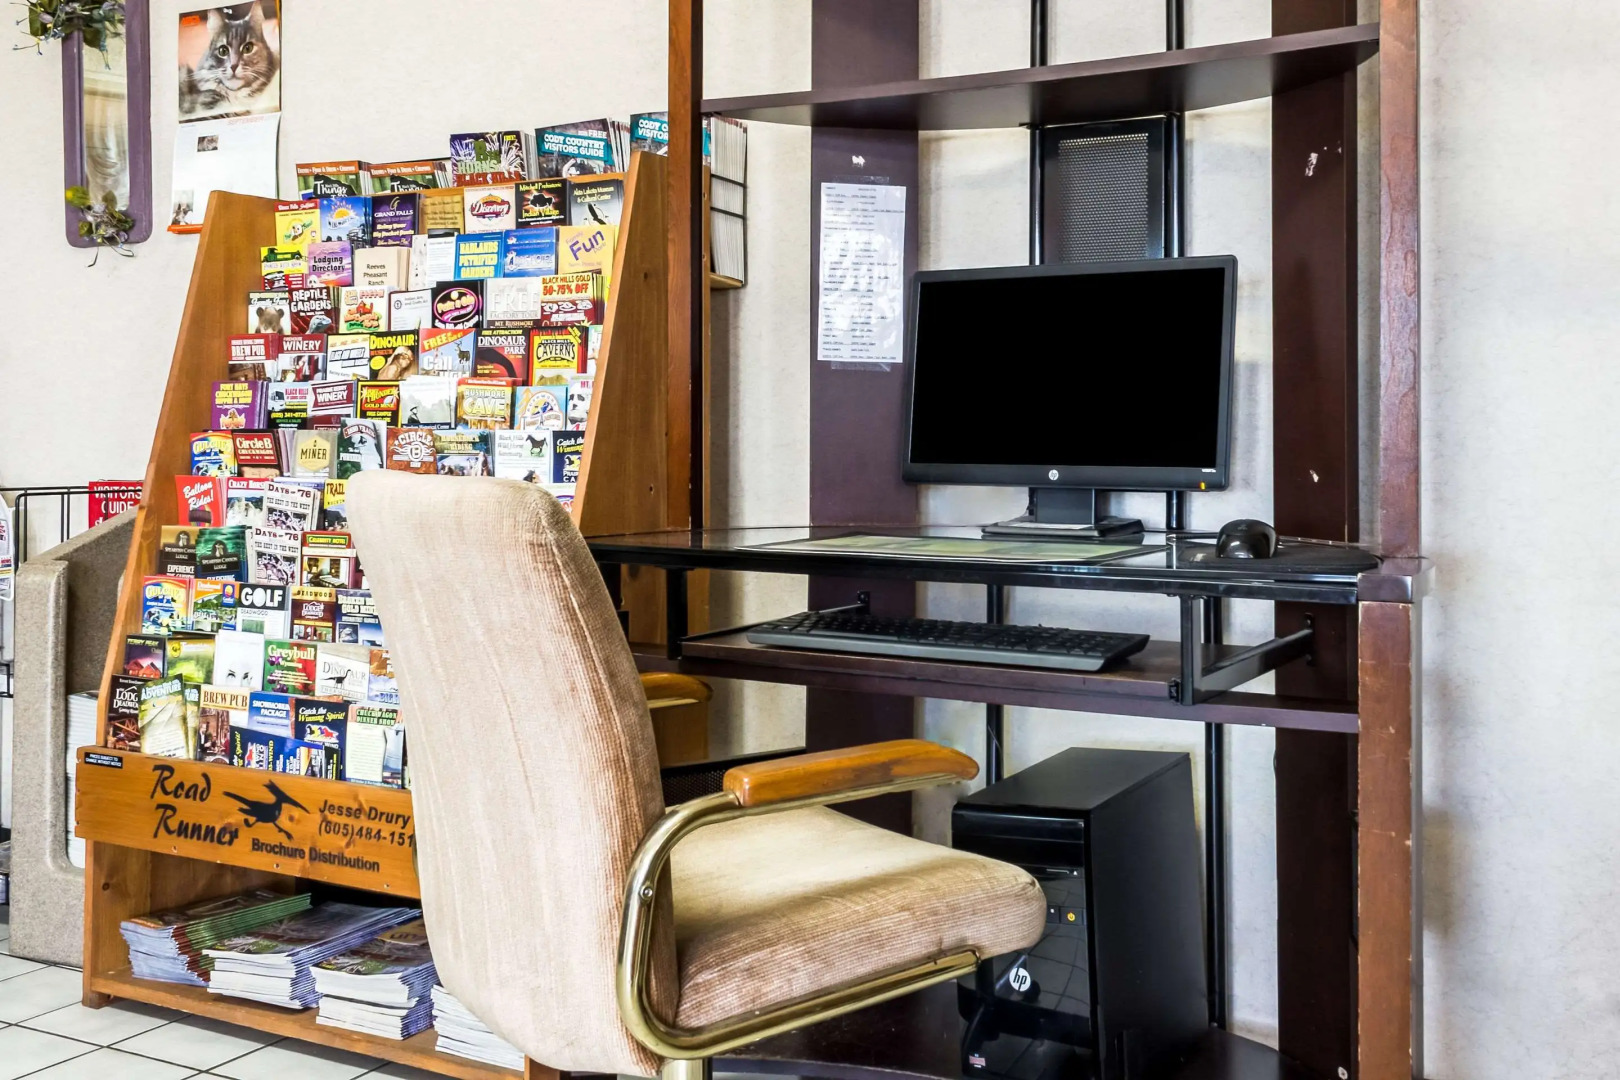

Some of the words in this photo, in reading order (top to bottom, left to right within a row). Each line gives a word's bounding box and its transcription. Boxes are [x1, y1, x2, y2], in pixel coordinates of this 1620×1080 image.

[638, 119, 660, 129] CODY
[637, 127, 668, 140] VISITOR
[544, 134, 564, 145] CODY
[565, 137, 605, 150] COUNTRY
[544, 142, 578, 154] VISITORS
[579, 147, 604, 157] GUIDE
[314, 180, 347, 197] Things
[396, 209, 414, 217] FALLS
[522, 209, 539, 218] Indian
[541, 208, 560, 217] Village
[569, 230, 604, 261] Fun
[314, 256, 344, 264] Lodging
[312, 264, 346, 272] Directory
[575, 274, 591, 282] GOLD
[292, 288, 328, 300] REPTILE
[543, 284, 573, 295] 50-75%
[575, 283, 589, 294] OFF
[291, 300, 332, 312] GARDENS
[283, 341, 321, 351] WINERY
[423, 333, 448, 351] FREE
[478, 336, 526, 346] DINOSAUR
[252, 345, 265, 356] PUB
[504, 346, 526, 355] PARK
[536, 343, 576, 361] CAVERNS
[423, 355, 452, 371] Call
[316, 390, 348, 403] WINERY
[465, 388, 505, 397] RUSHMORE
[463, 397, 506, 417] CAVE
[236, 437, 263, 449] Circle
[264, 438, 272, 449] B
[556, 438, 576, 446] Catch
[300, 448, 327, 460] MINER
[1049, 470, 1058, 480] hp
[325, 482, 345, 497] TRAIL
[167, 564, 195, 574] EXPERIENCE
[241, 587, 284, 607] GOLF
[296, 590, 333, 598] DEADWOOD
[267, 644, 316, 661] Greybull
[116, 689, 138, 701] LODG
[203, 690, 228, 704] BREW
[229, 693, 248, 707] PUB
[261, 708, 287, 718] PACKAGE
[298, 706, 316, 715] Catch
[316, 705, 327, 714] the
[378, 718, 396, 726] SHOW
[150, 764, 211, 802] Road
[318, 799, 362, 819] Jesse
[368, 808, 411, 828] Drury
[153, 803, 239, 847] Runner
[318, 818, 414, 849] (605)484-151
[252, 838, 306, 859] Brochure
[309, 847, 380, 873] Distribution
[1010, 967, 1029, 992] hp
